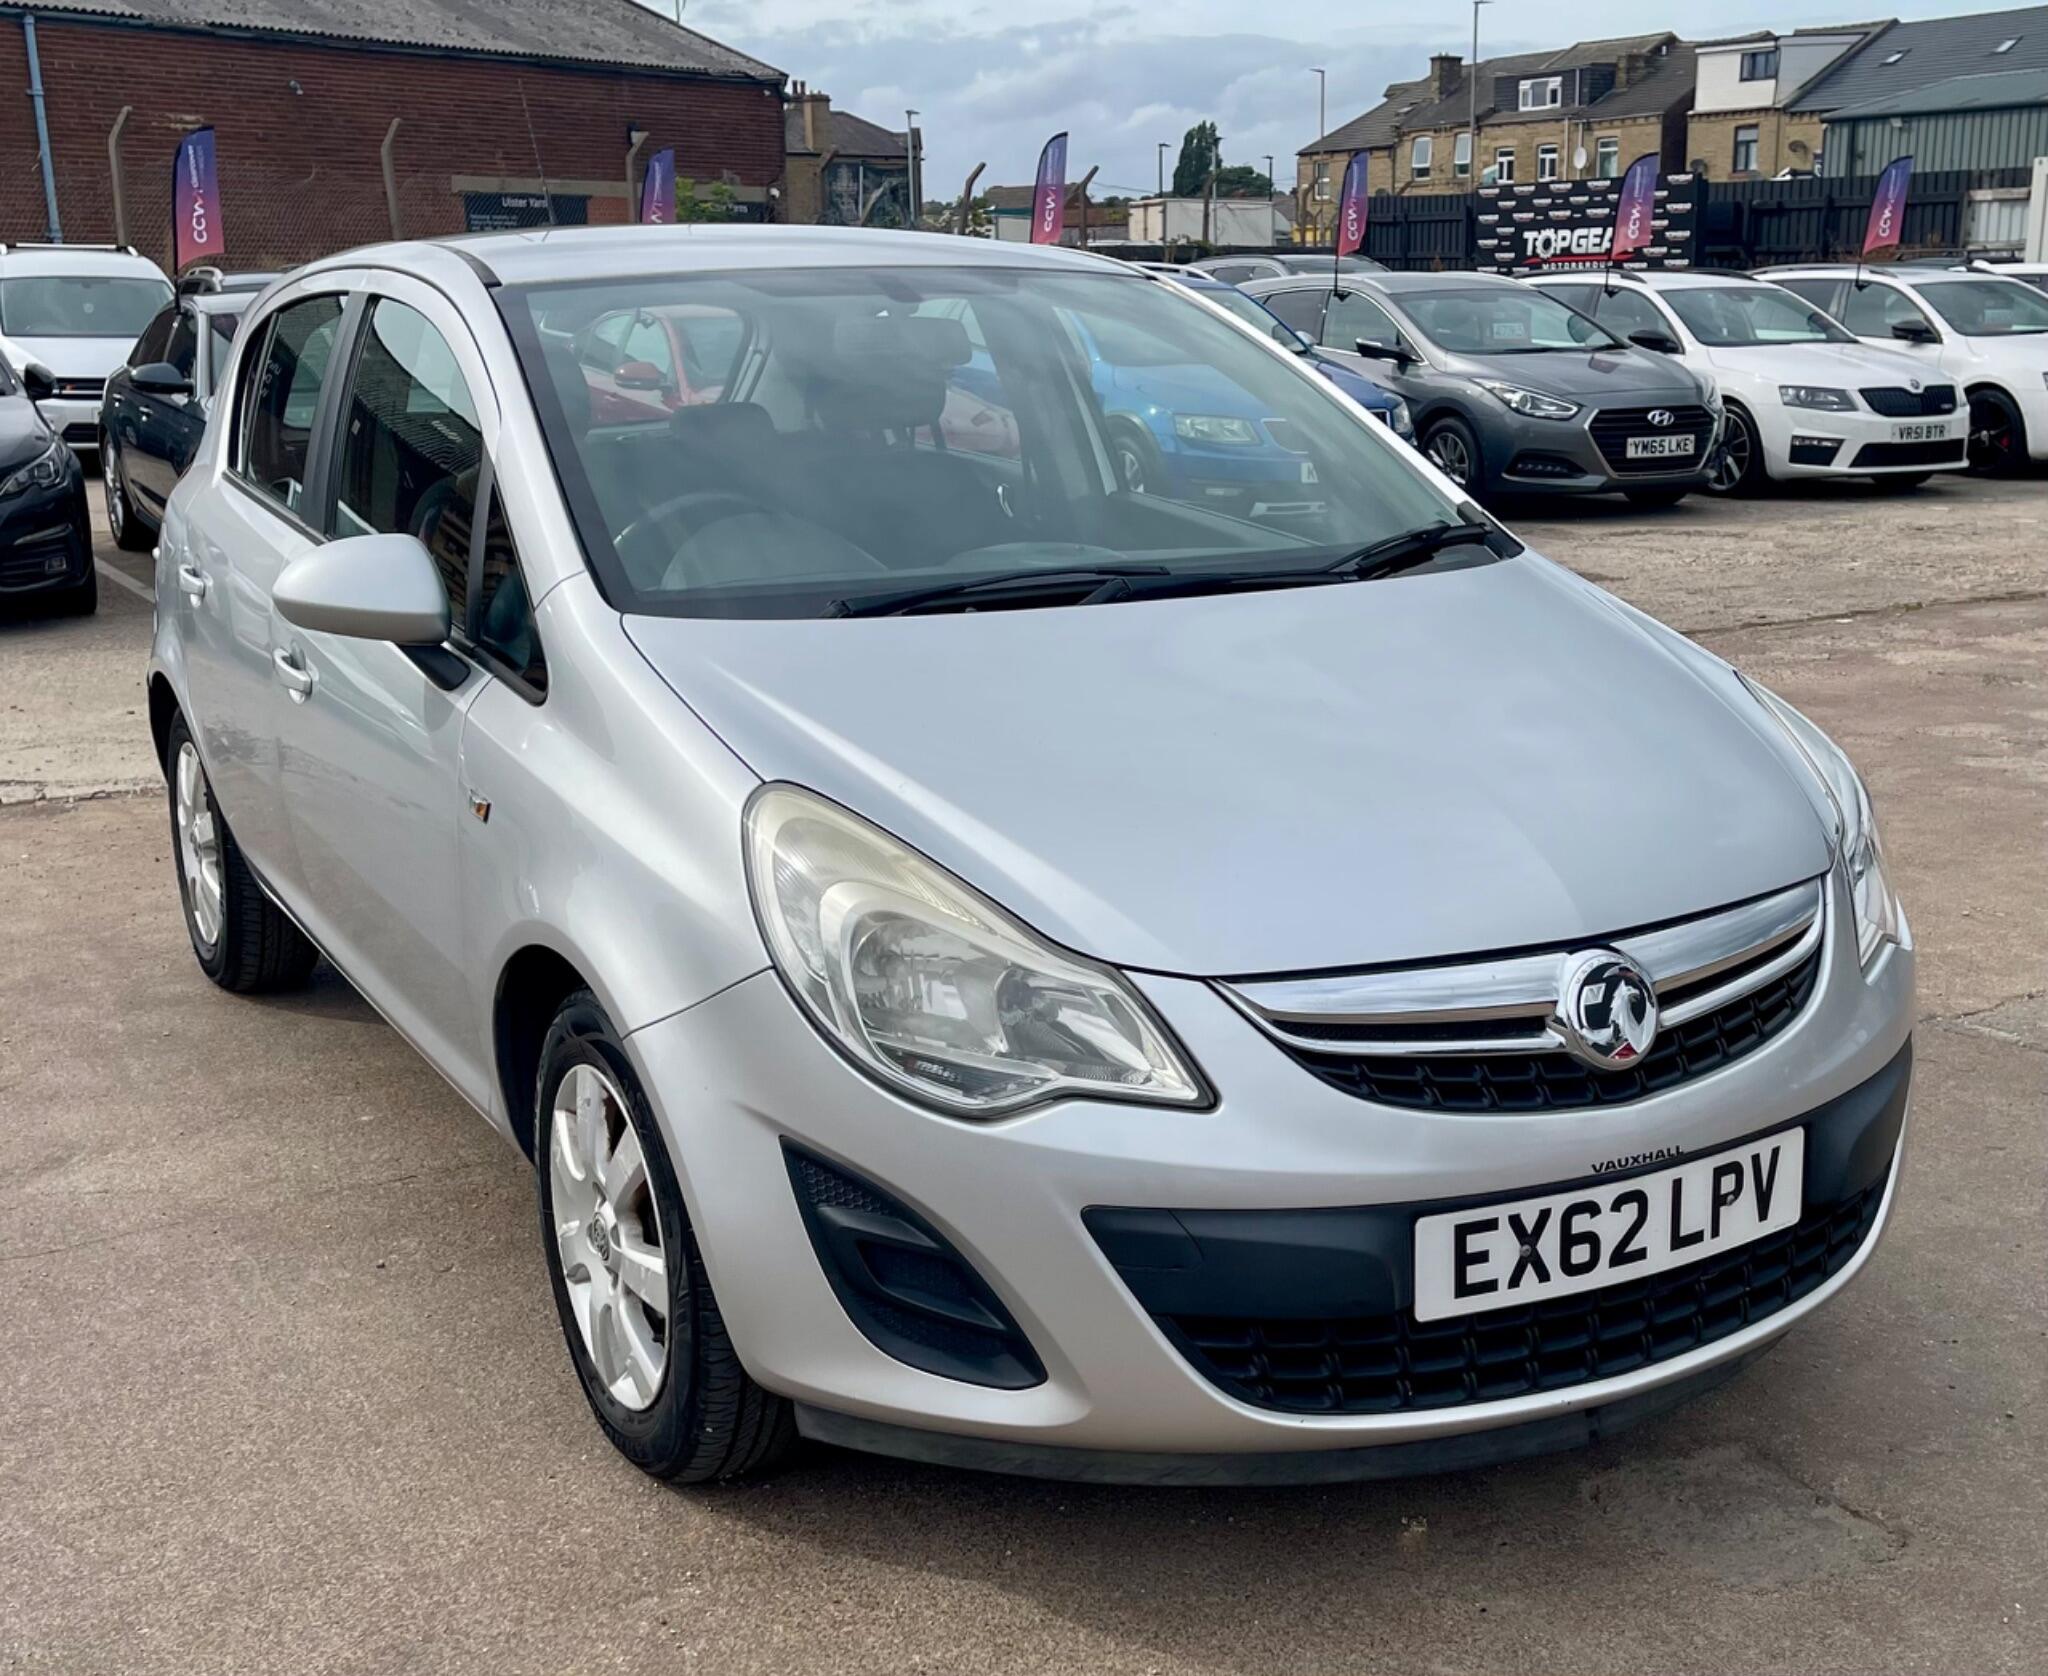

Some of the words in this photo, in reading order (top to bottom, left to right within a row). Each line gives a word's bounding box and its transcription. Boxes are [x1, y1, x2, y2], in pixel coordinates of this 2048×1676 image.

[1522, 227, 1633, 258] TOPGEA
[1633, 438, 1666, 455] YM65
[1667, 437, 1690, 453] LKE
[1591, 1145, 1685, 1174] VAUXHALL
[1453, 1188, 1650, 1300] EX62
[1670, 1145, 1782, 1253] LPV
